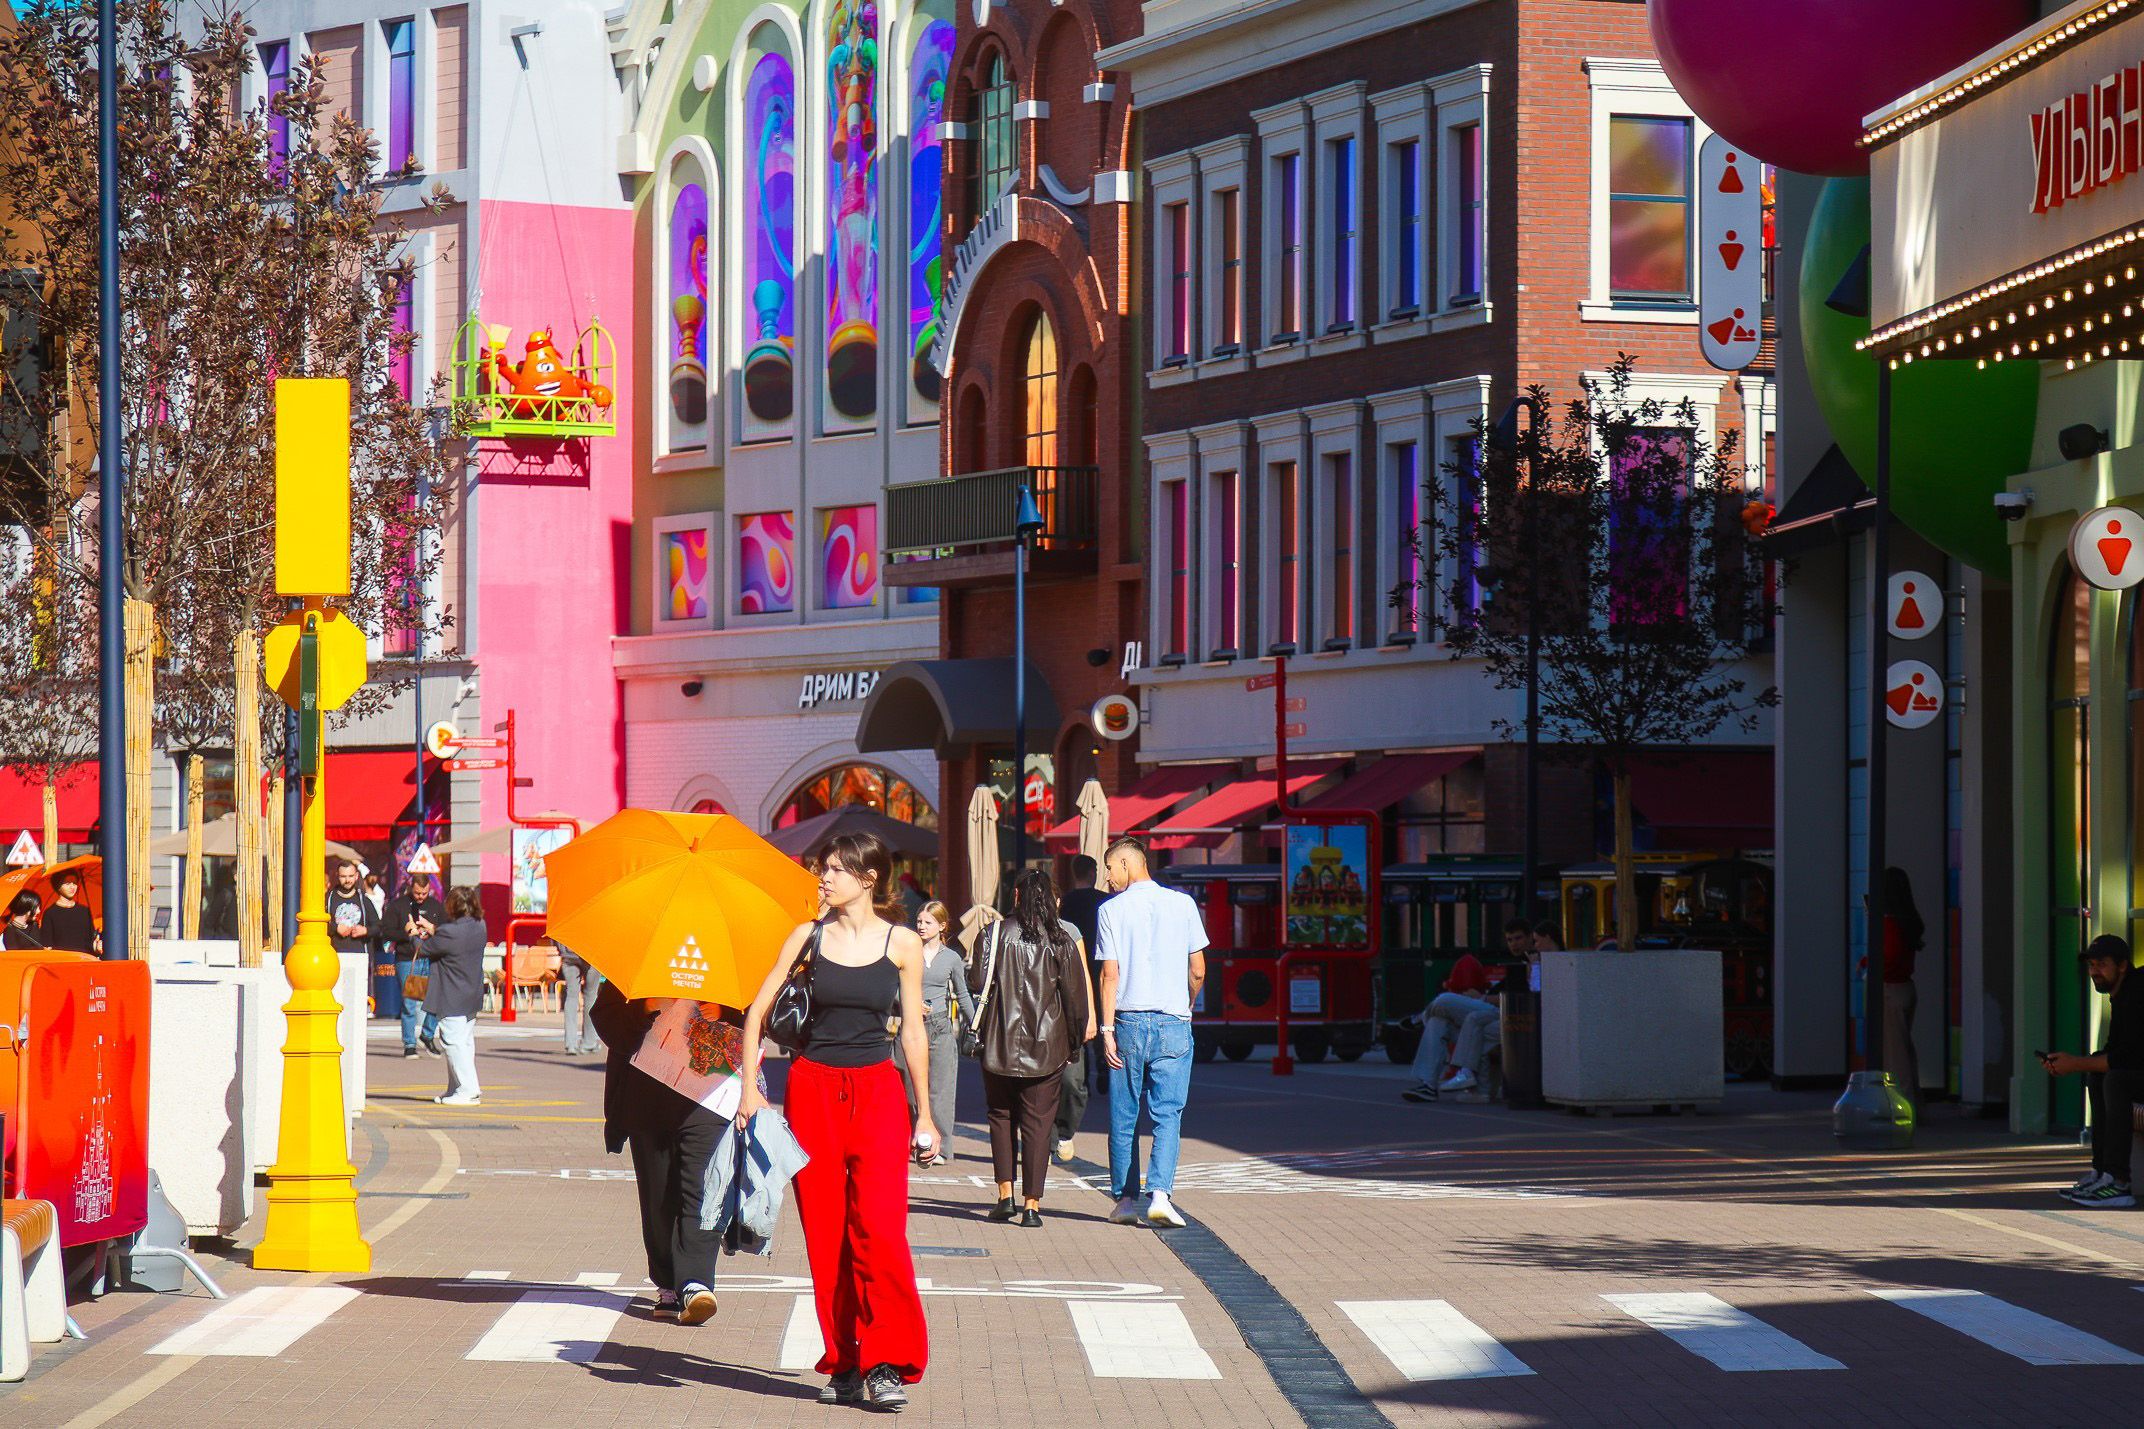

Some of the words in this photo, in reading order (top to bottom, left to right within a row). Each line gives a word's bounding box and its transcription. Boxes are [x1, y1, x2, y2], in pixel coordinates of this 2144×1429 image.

[798, 671, 854, 709] ДРИМ
[671, 971, 704, 982] ОСТРОВ
[673, 979, 702, 988] МЕЧТЫ
